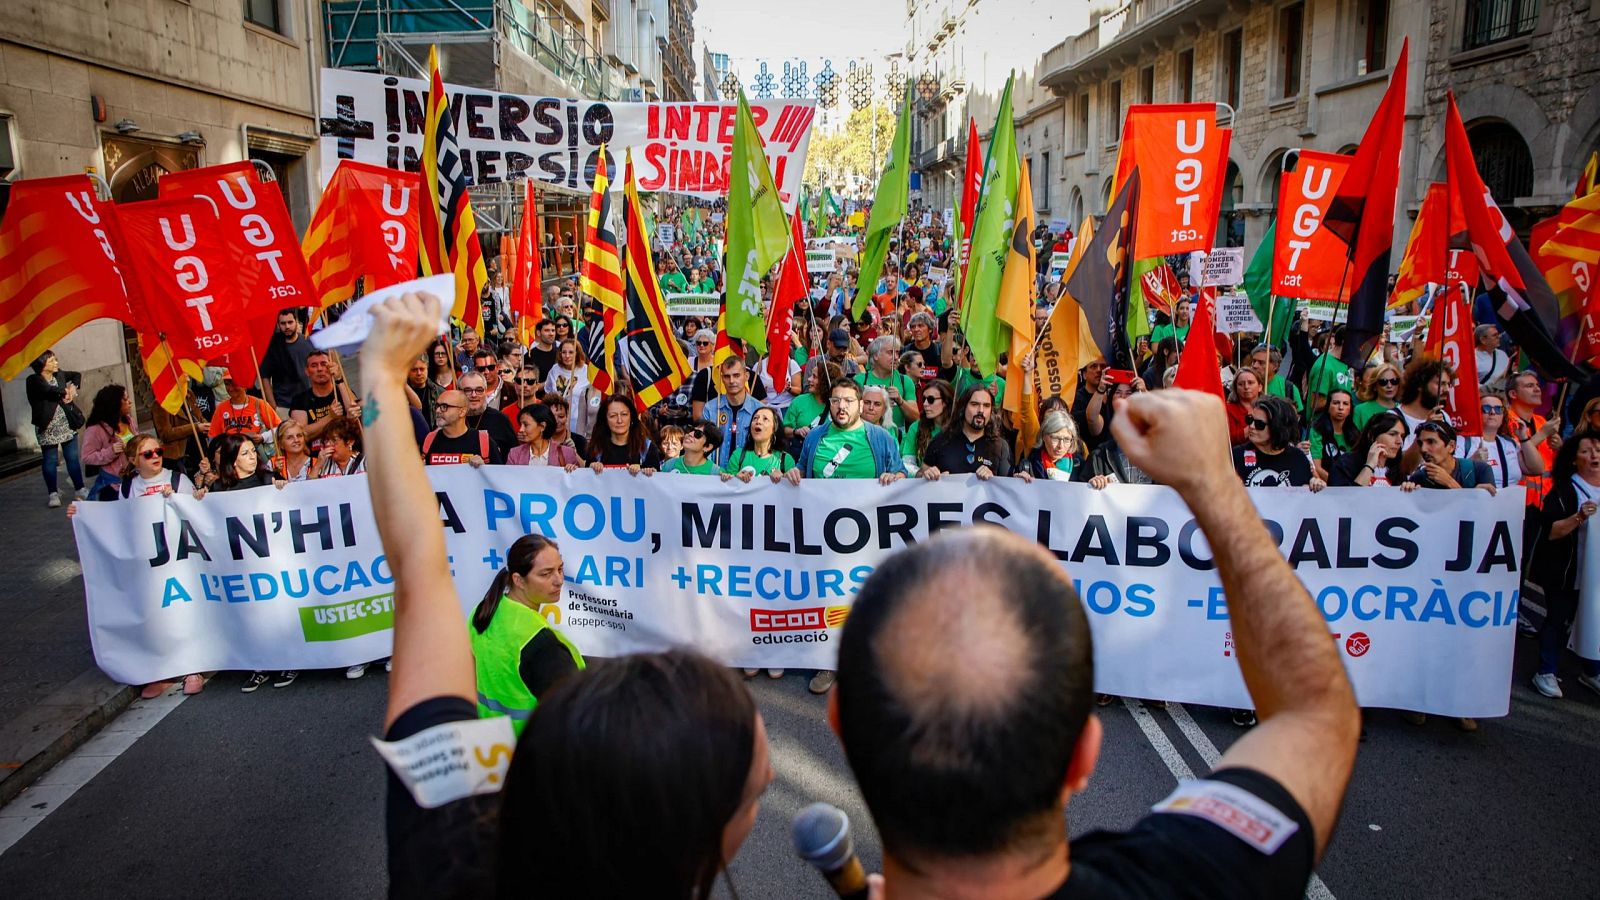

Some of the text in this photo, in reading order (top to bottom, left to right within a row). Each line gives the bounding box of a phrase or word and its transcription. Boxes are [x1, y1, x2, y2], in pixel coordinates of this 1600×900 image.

[1288, 165, 1332, 272] UGT
[431, 455, 459, 463] CCOO
[149, 520, 212, 568] JA
[484, 488, 662, 554] PROU,
[1445, 520, 1517, 574] JA
[161, 576, 192, 608] A
[671, 564, 876, 601] +RECURS
[568, 590, 618, 607] Professors
[568, 602, 634, 620] de Secundària
[754, 612, 819, 628] CCOO
[752, 630, 829, 646] educació
